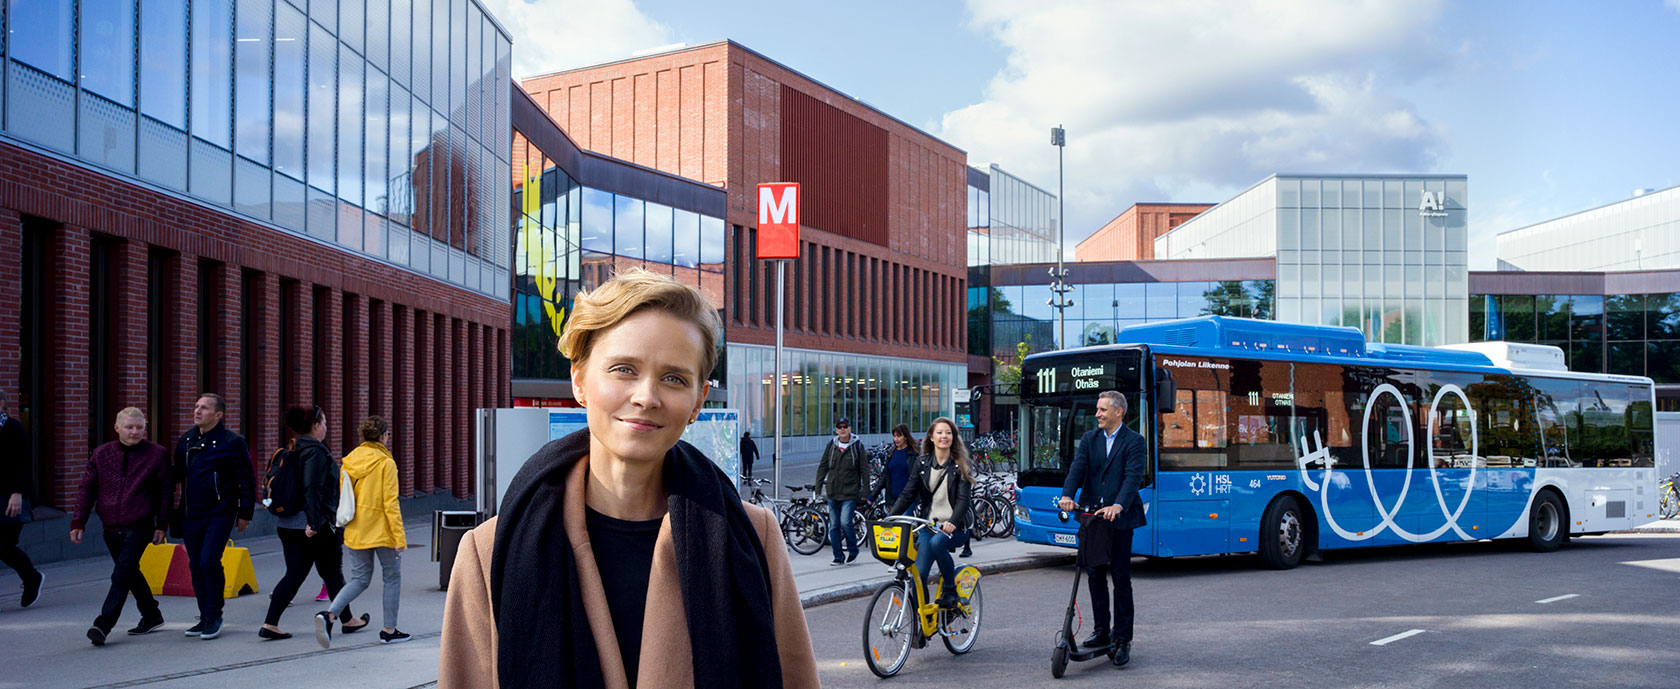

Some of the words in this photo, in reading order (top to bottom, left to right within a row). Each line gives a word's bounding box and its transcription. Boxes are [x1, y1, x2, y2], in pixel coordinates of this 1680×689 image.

[759, 186, 796, 224] M
[1419, 191, 1444, 210] A!
[1163, 359, 1196, 368] Pohjolan
[1198, 361, 1230, 370] Liikenne
[1071, 365, 1104, 377] Otaniemi
[1036, 367, 1056, 394] 111
[1075, 378, 1099, 389] Otnäs
[1248, 391, 1259, 406] 111
[1215, 474, 1232, 484] HSL
[1249, 479, 1261, 488] 464
[1215, 485, 1232, 493] HRT
